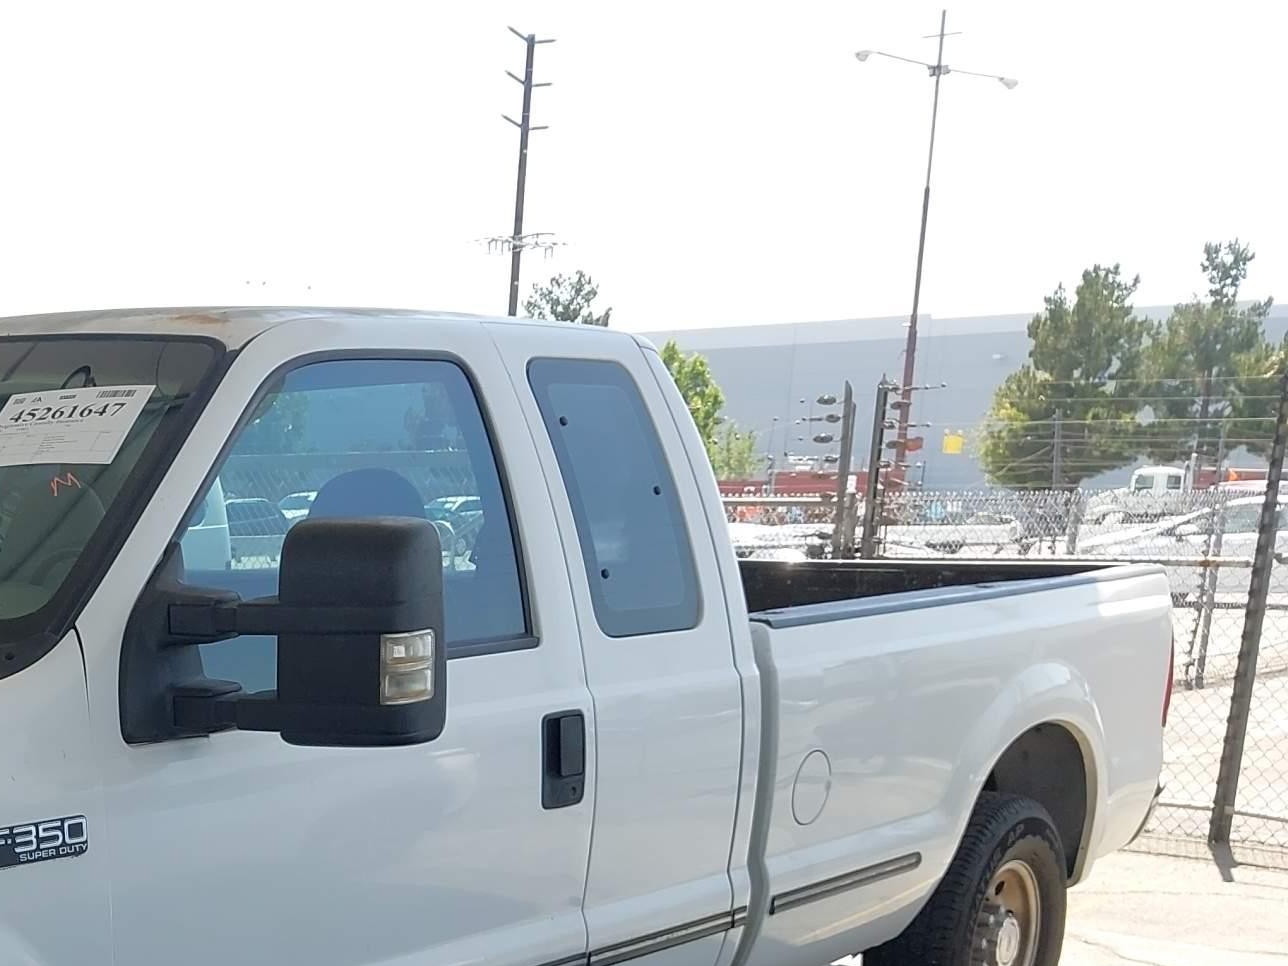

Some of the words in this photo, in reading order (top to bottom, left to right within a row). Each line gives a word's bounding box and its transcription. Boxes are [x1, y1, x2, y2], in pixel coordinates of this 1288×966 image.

[9, 402, 126, 423] 45261647
[19, 848, 57, 862] SUPER
[59, 843, 88, 856] DUTY
